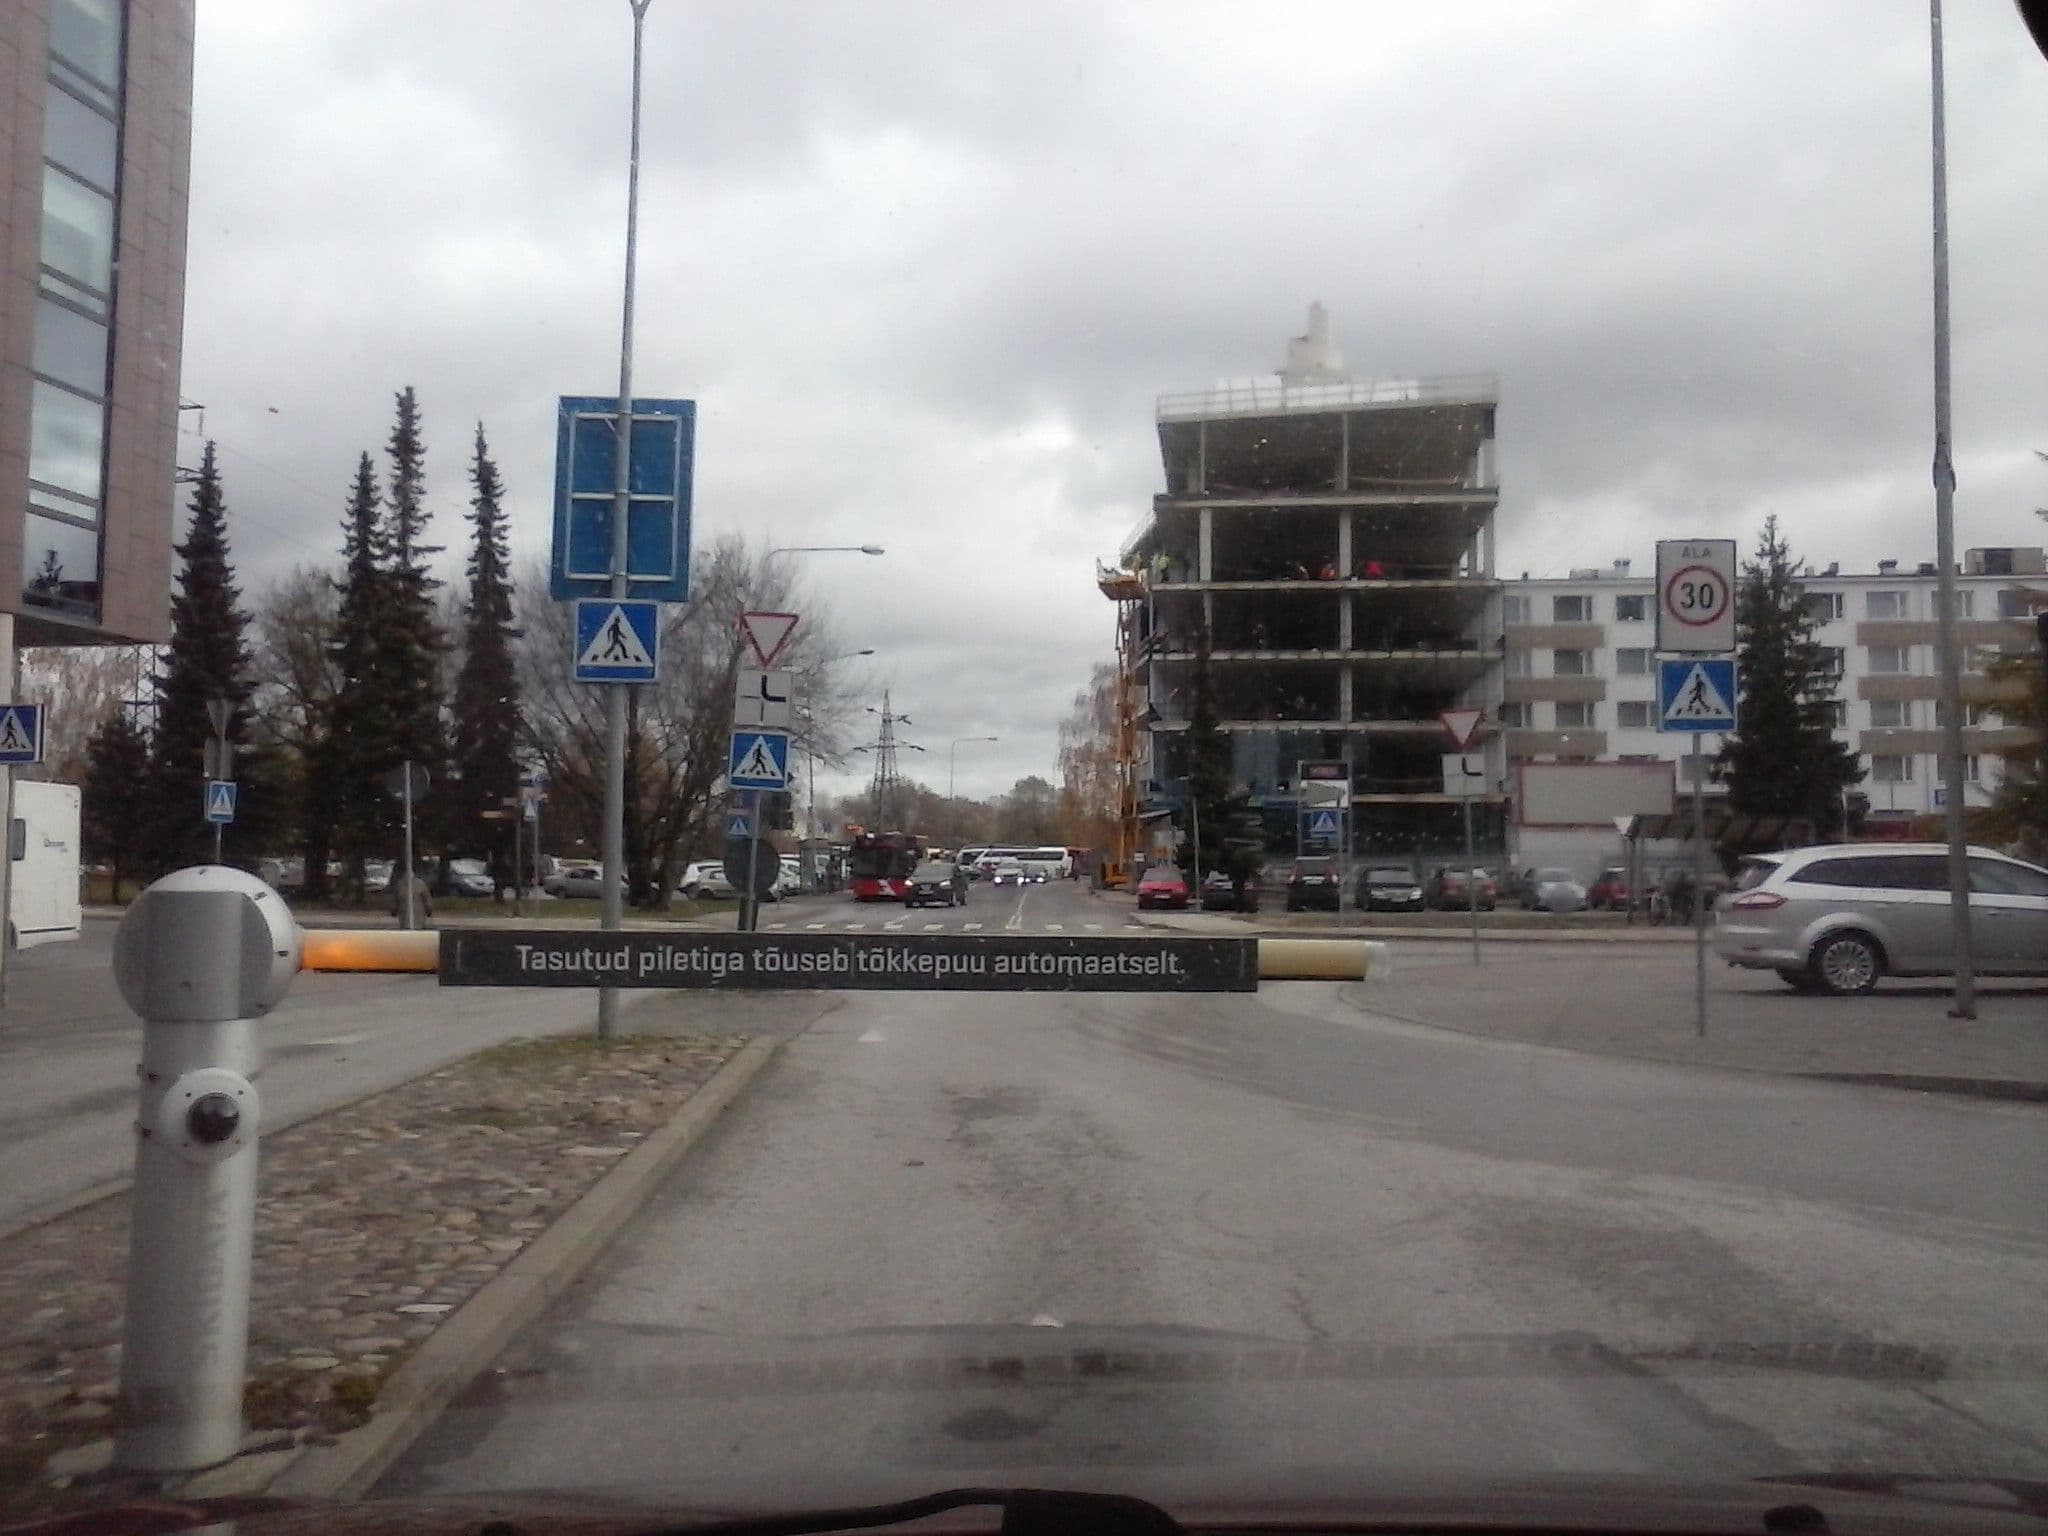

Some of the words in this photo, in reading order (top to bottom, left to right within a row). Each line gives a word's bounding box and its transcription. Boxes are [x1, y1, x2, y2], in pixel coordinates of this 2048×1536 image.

[1682, 546, 1711, 558] ALA
[1680, 582, 1714, 609] 30
[515, 945, 630, 972] Tasutud
[638, 946, 745, 978] piletiga
[752, 946, 849, 972] tõuseb
[857, 948, 986, 979] tõkkepuu
[994, 948, 1186, 975] automaatselt.
